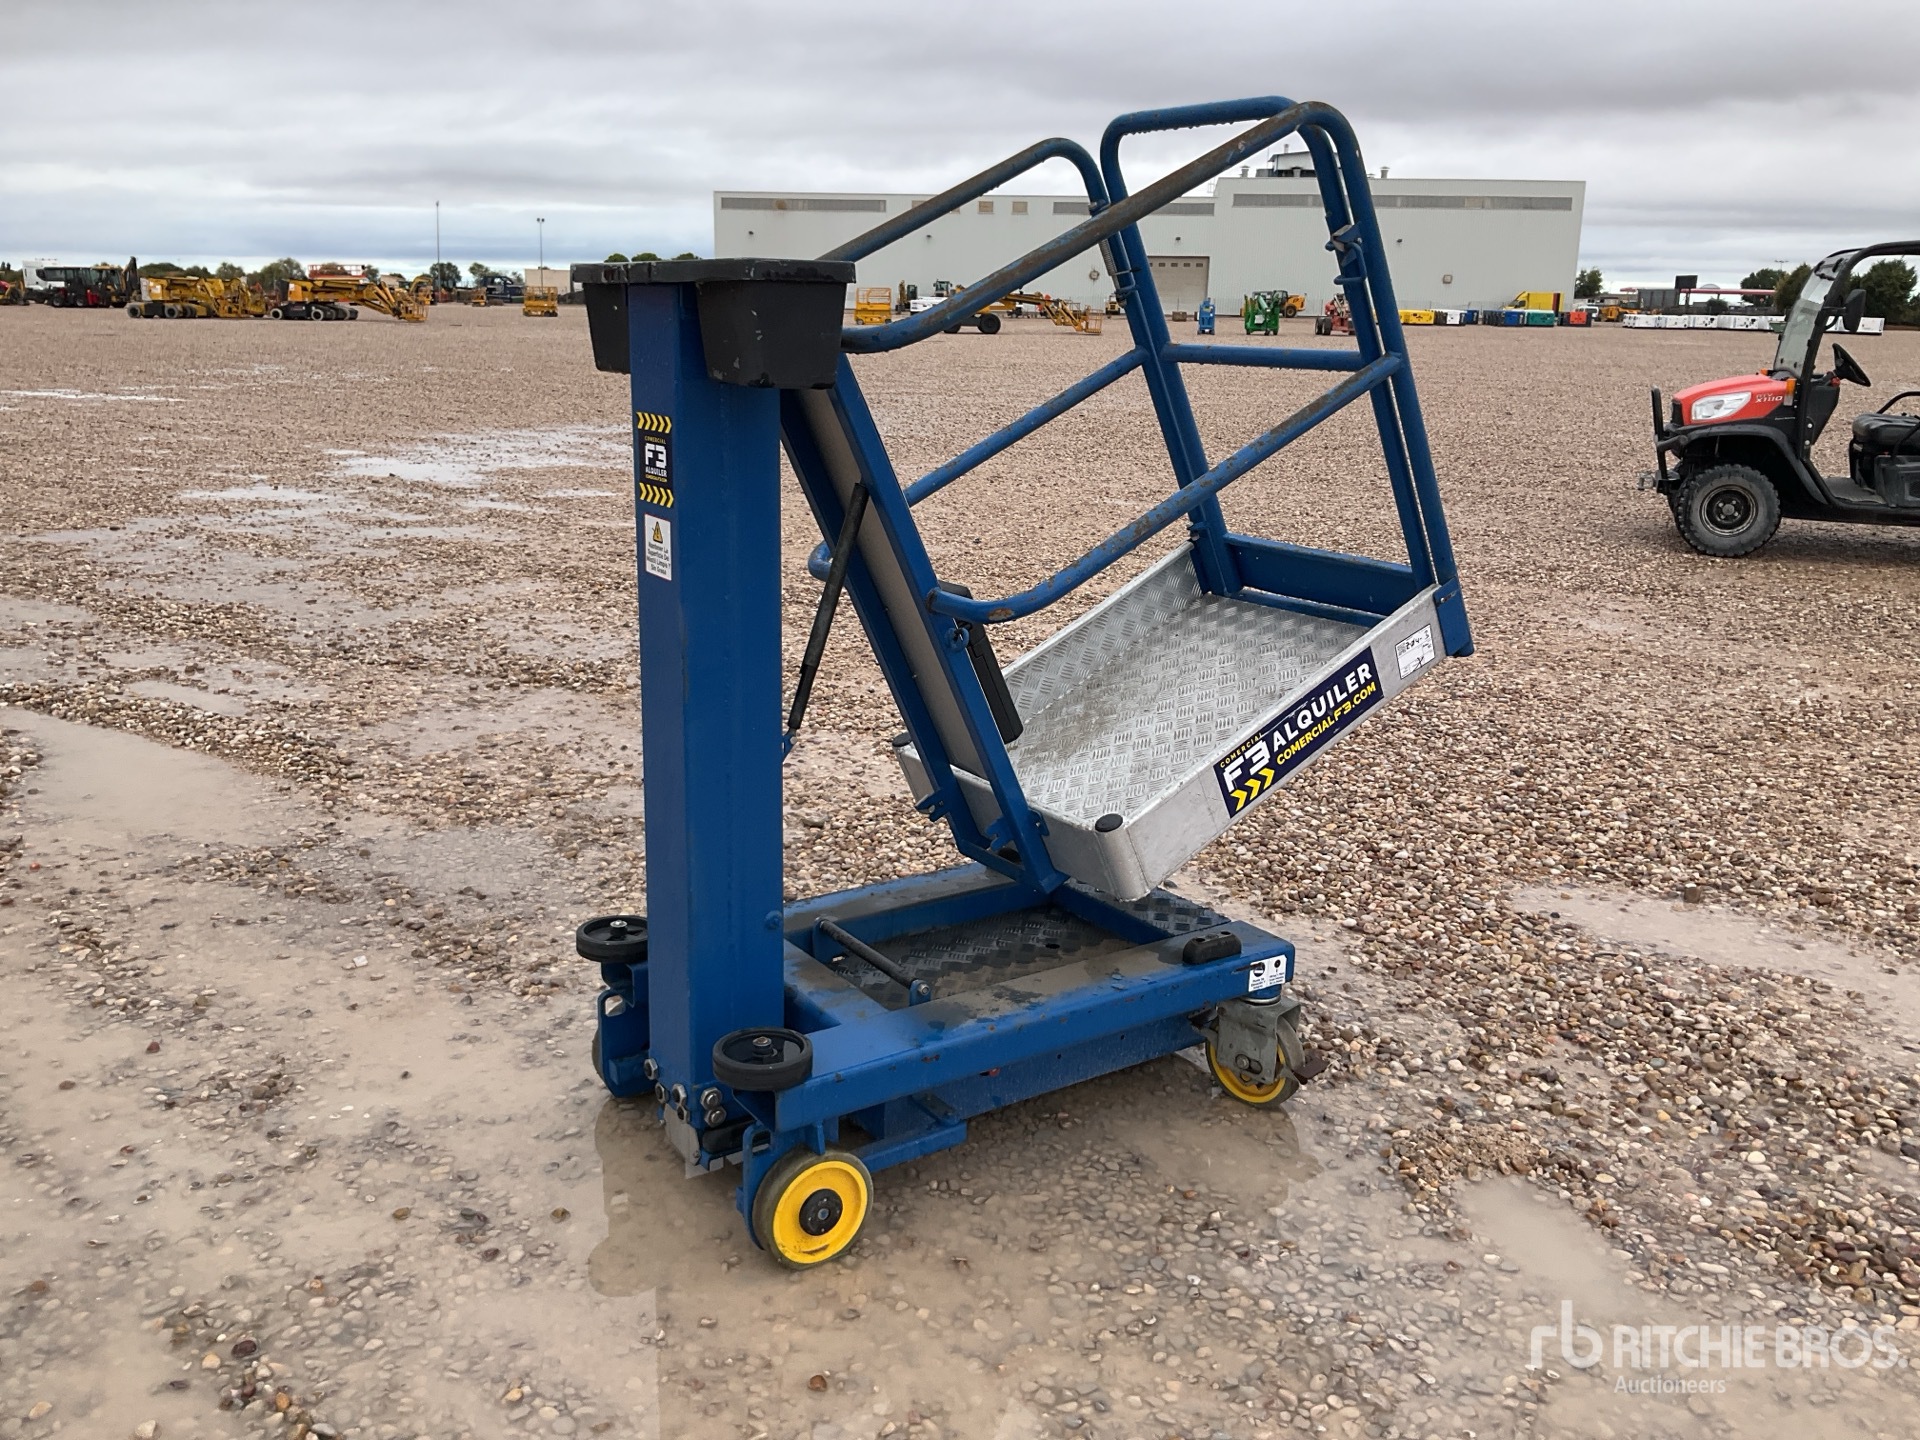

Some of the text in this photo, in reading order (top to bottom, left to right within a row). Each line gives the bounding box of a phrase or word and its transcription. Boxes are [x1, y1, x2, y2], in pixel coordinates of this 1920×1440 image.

[645, 442, 667, 469] F3
[645, 465, 668, 478] ALQUILER
[1273, 662, 1372, 752] ALQUILER
[1276, 681, 1377, 765] COMERCIALF3.COM
[1220, 732, 1264, 768] COMERCIAL
[1223, 739, 1270, 793] F3
